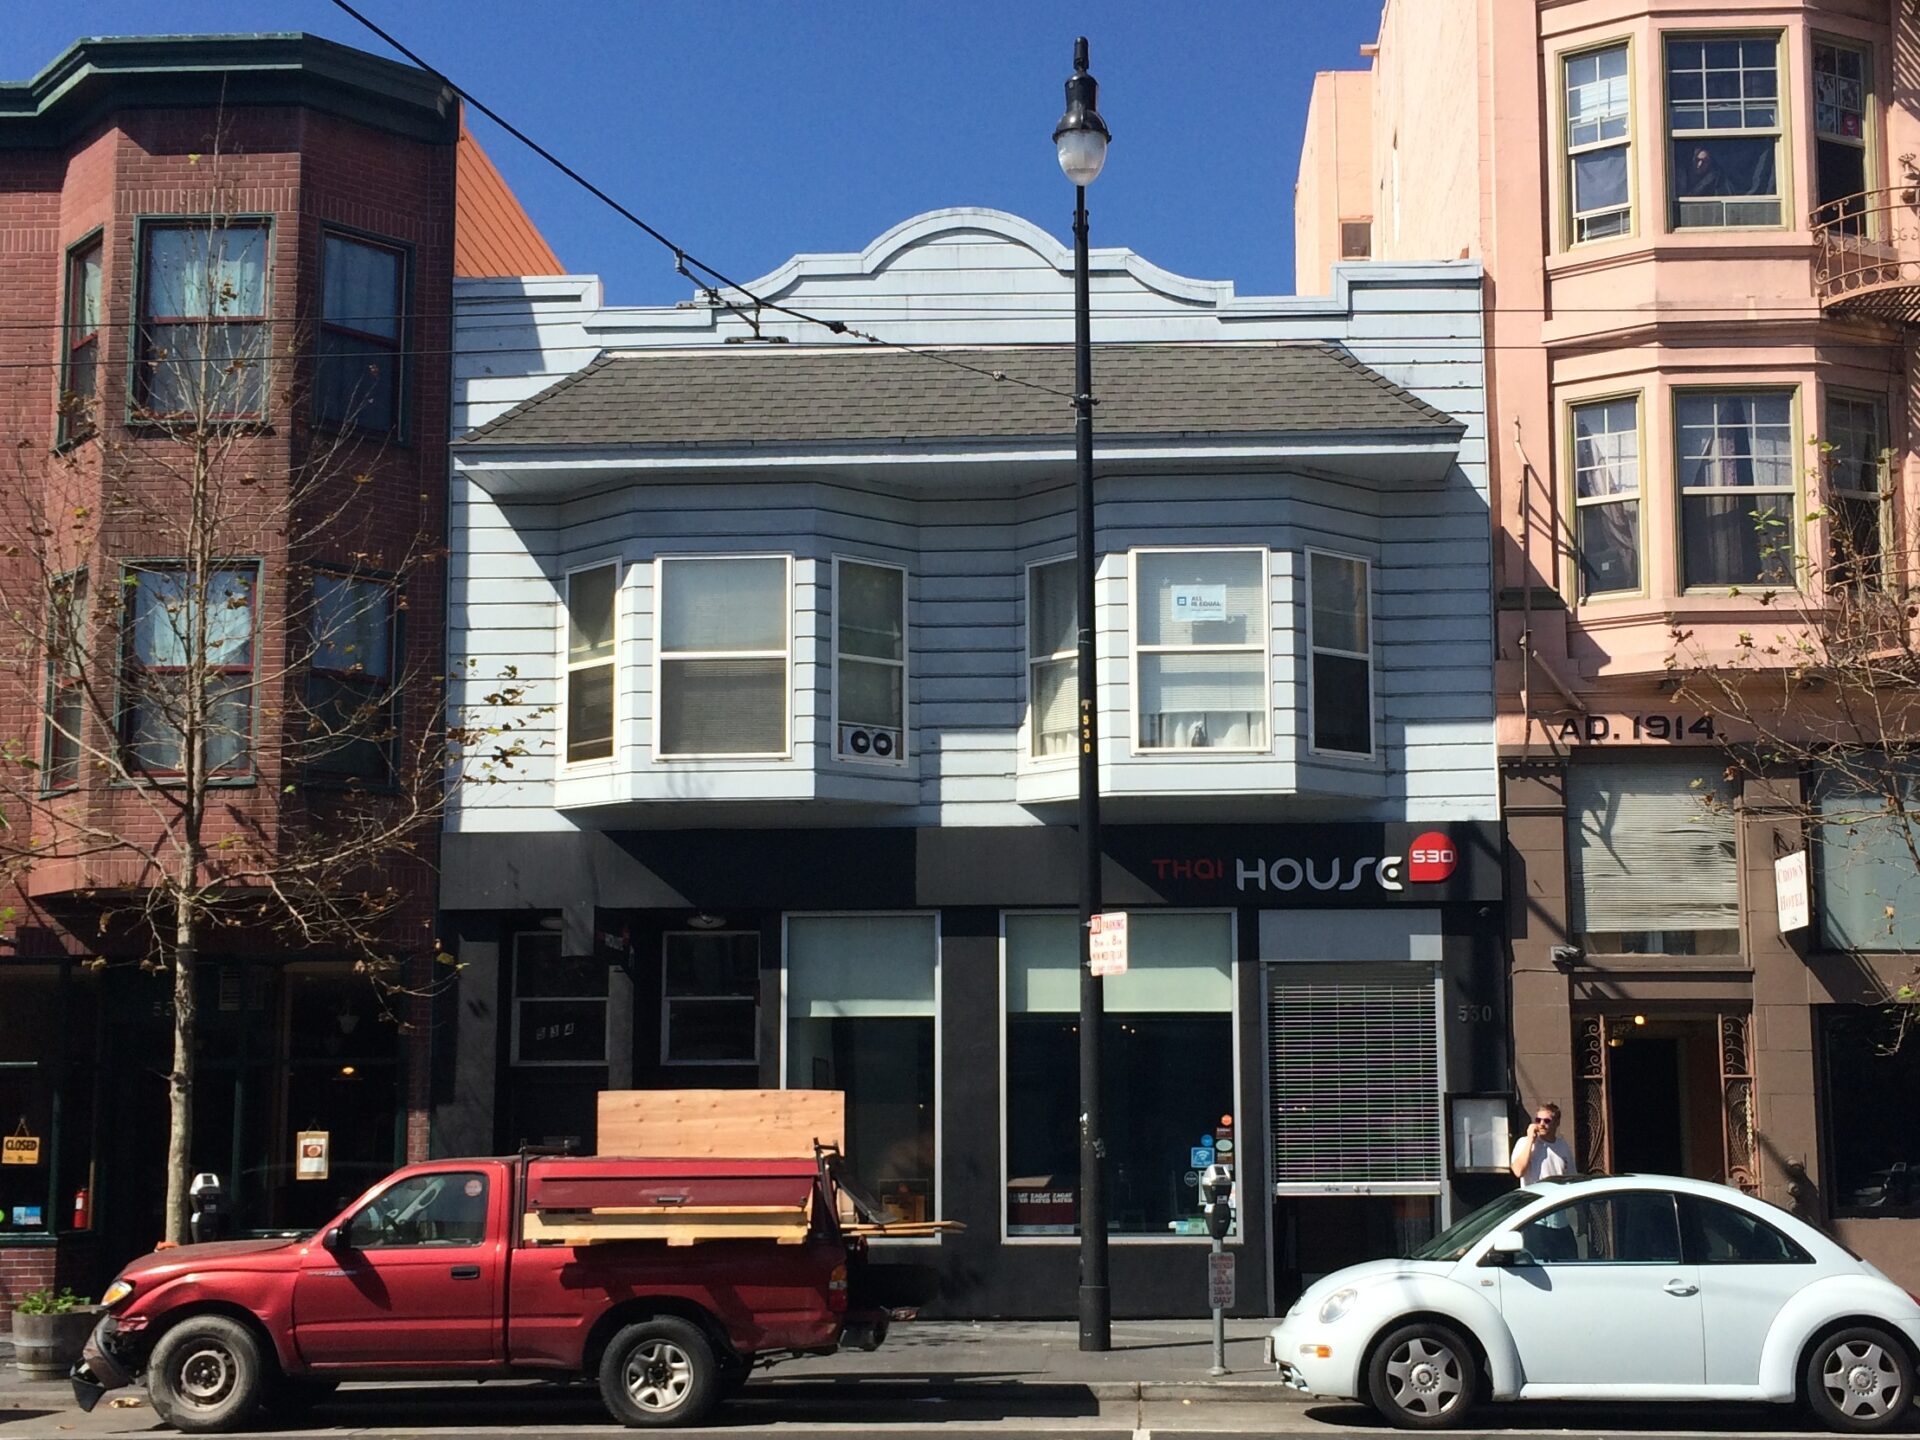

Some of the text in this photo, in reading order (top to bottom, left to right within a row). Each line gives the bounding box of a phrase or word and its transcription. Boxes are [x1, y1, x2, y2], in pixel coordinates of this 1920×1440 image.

[1411, 849, 1454, 864] 530
[1152, 856, 1404, 892] THAI HOUSE
[1780, 892, 1805, 911] HOTEL
[5, 1140, 37, 1151] CLOSED
